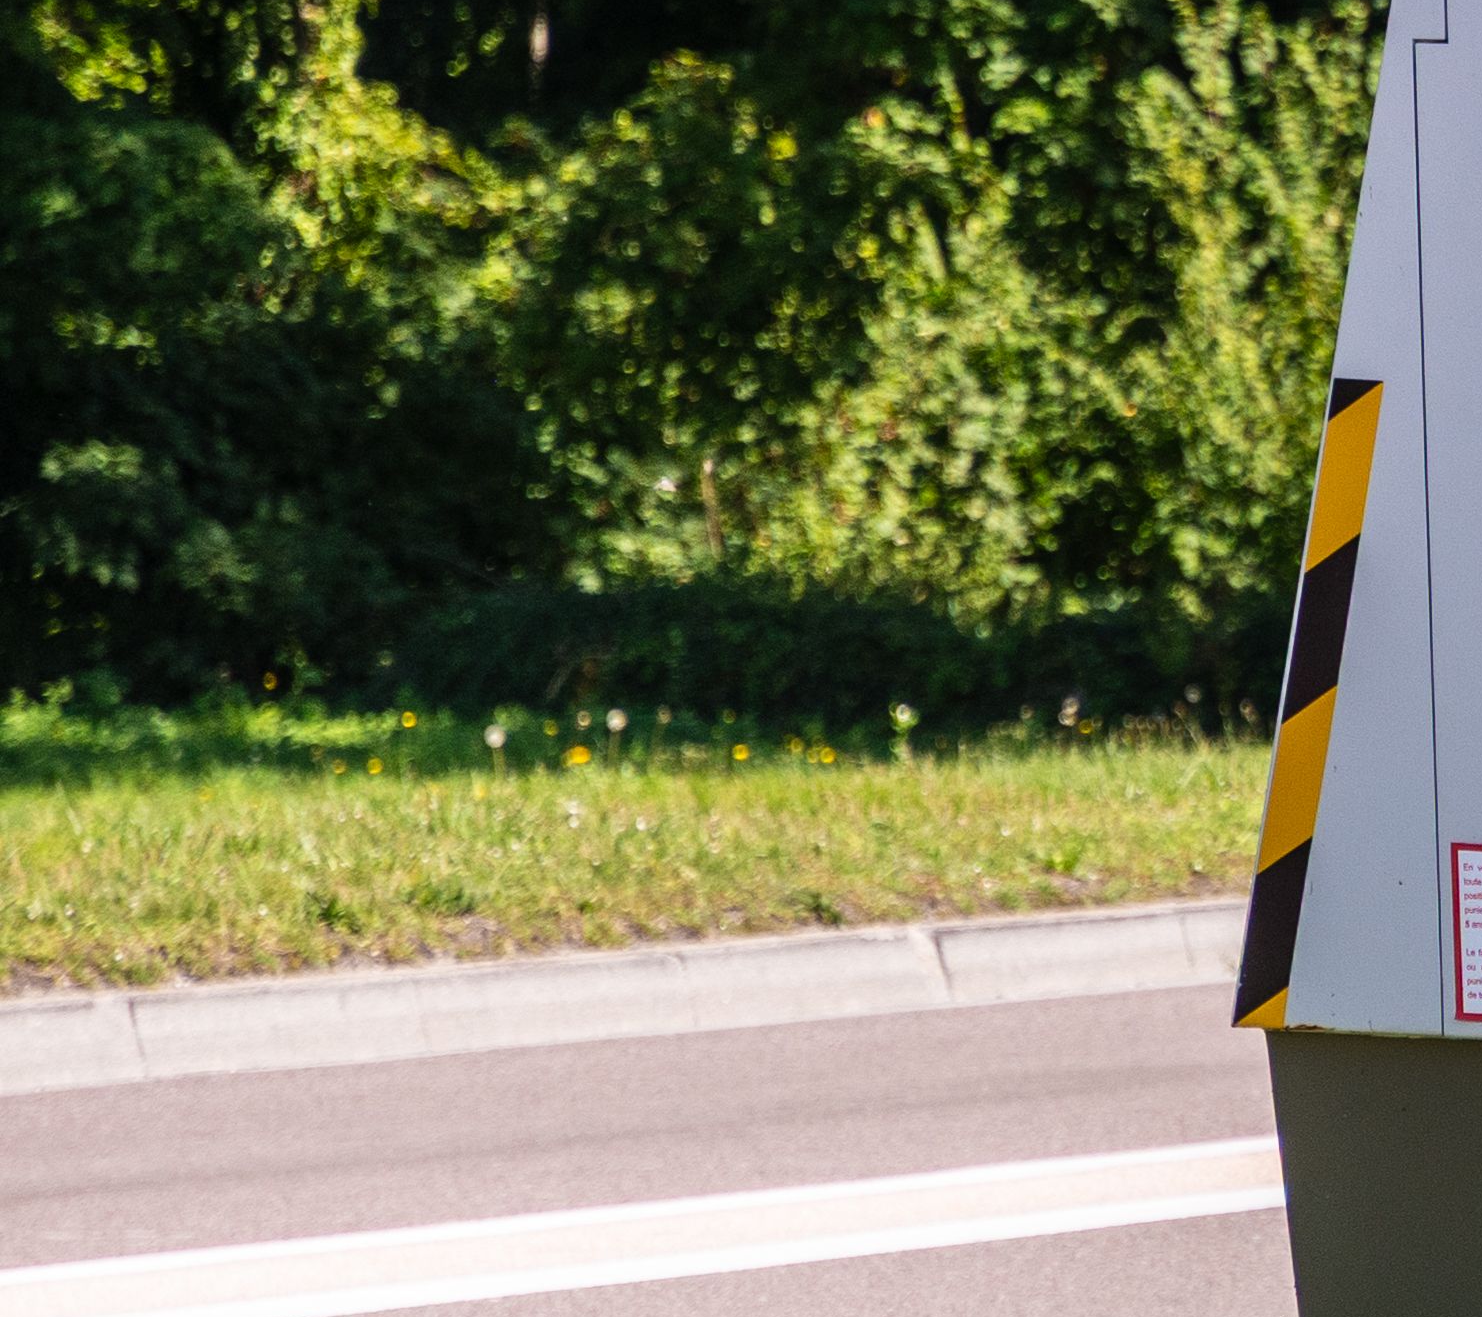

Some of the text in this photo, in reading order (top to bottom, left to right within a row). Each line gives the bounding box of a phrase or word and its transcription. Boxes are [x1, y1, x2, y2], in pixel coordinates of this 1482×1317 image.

[1463, 863, 1473, 871] En
[1464, 878, 1481, 886] toute
[1466, 949, 1476, 957] Le
[1467, 978, 1482, 986] puni
